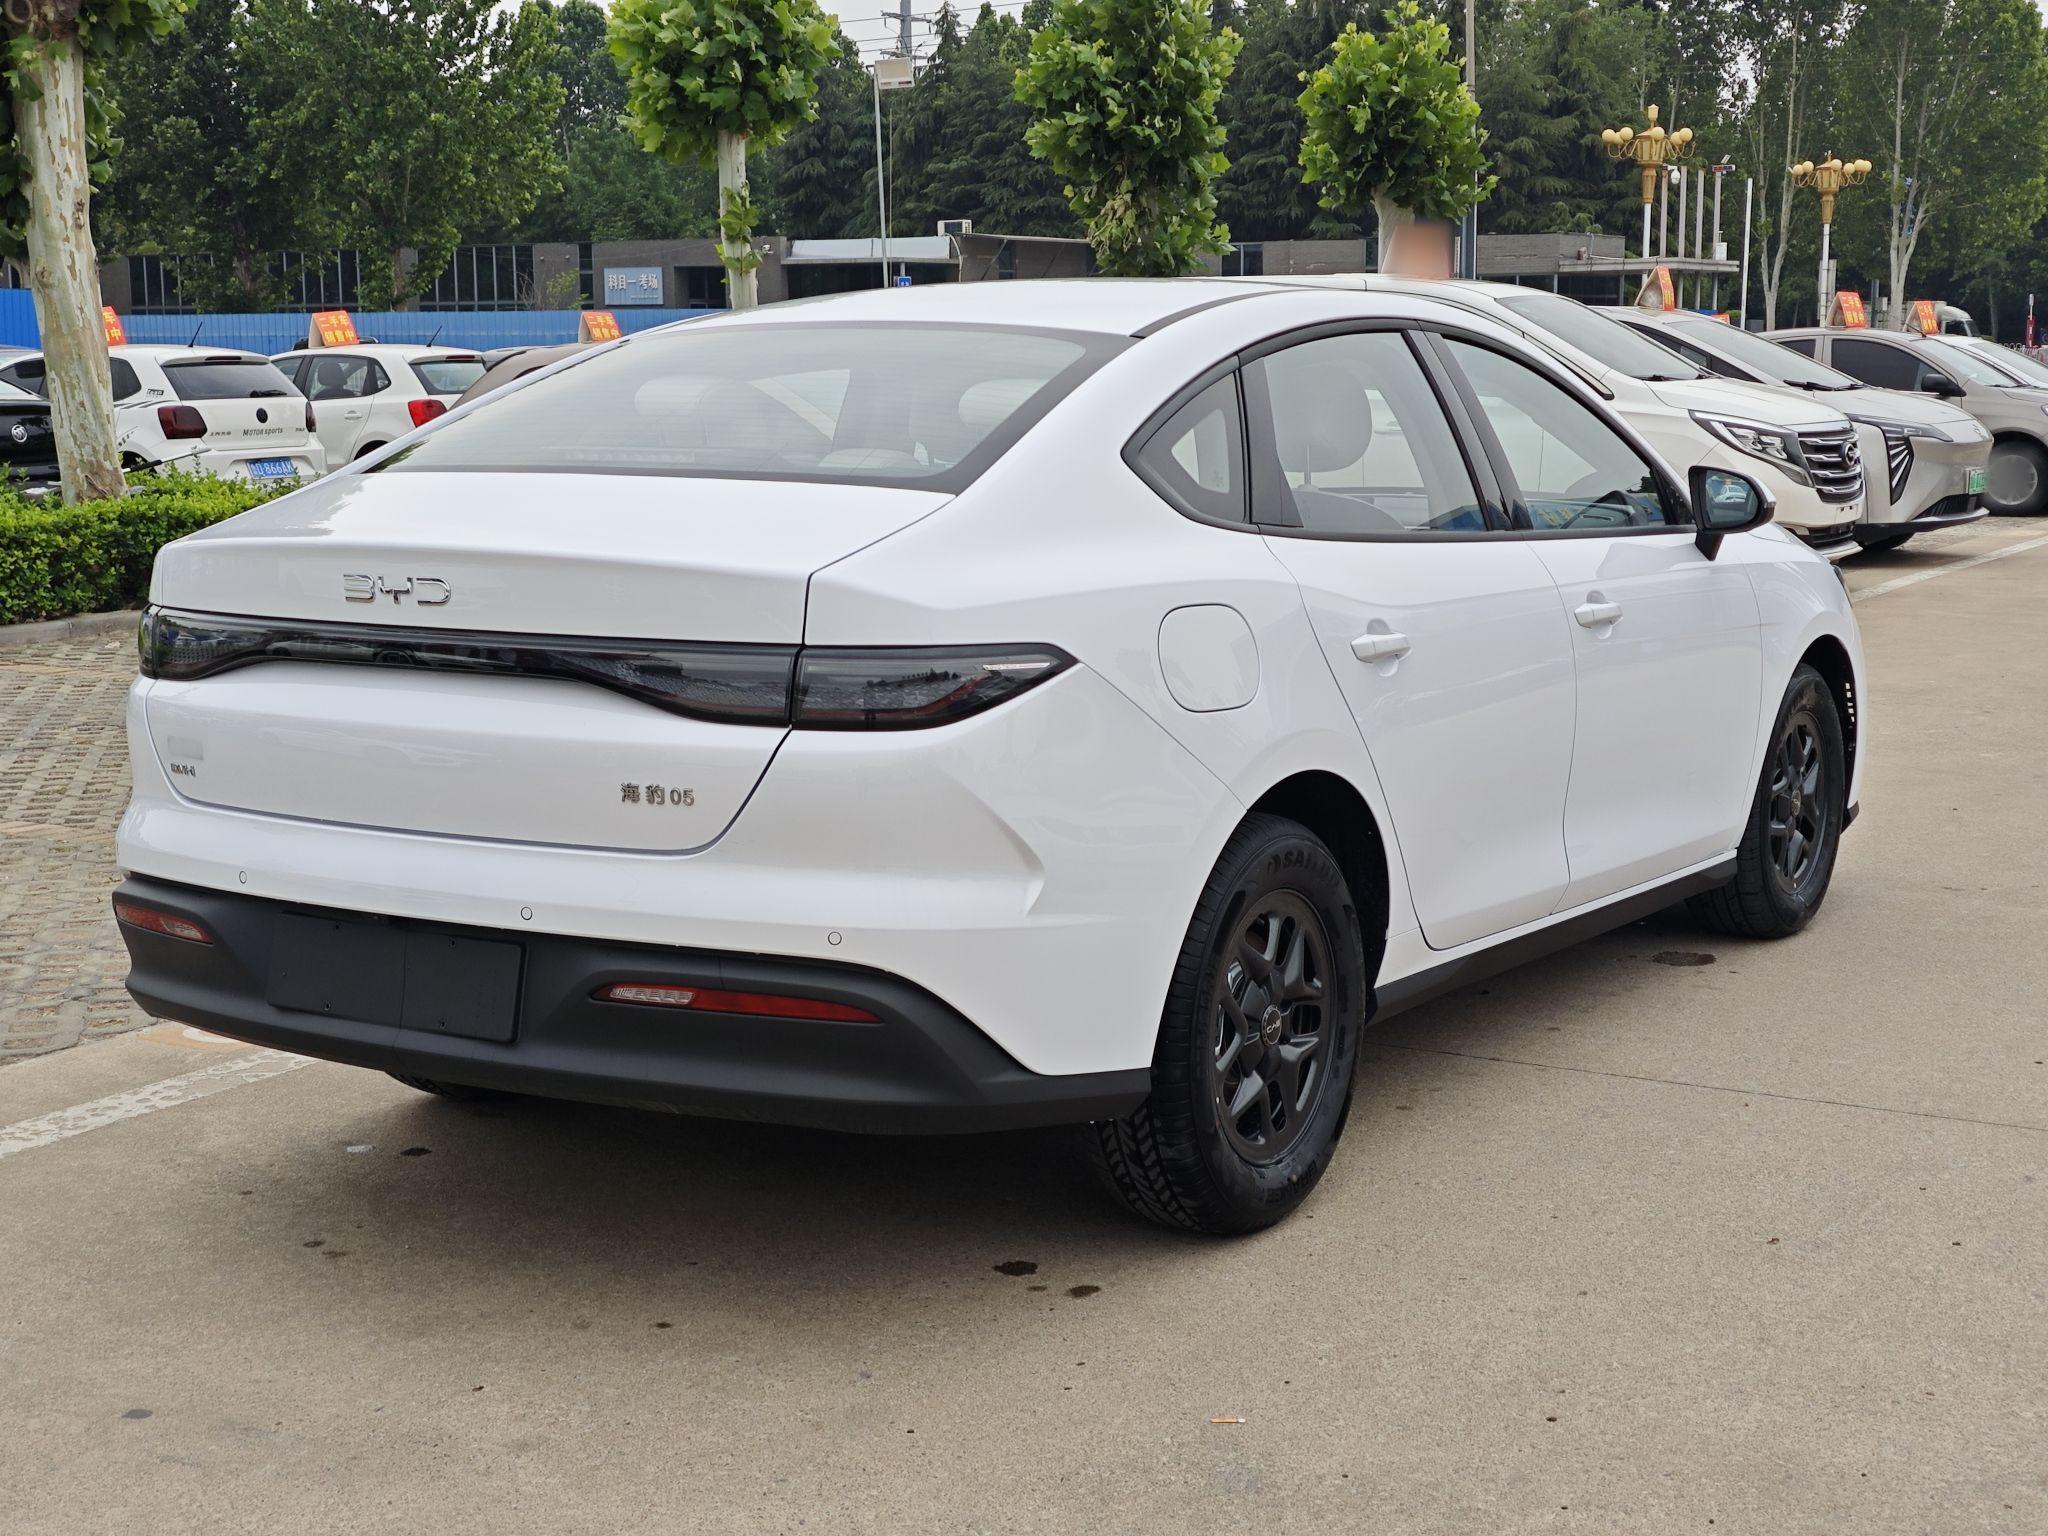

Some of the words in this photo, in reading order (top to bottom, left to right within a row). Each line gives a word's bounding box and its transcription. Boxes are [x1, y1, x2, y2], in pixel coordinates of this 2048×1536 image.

[608, 273, 658, 290] 科目一考场
[319, 314, 349, 328] 二手车
[588, 315, 615, 326] 二手车
[343, 574, 451, 606] BYD
